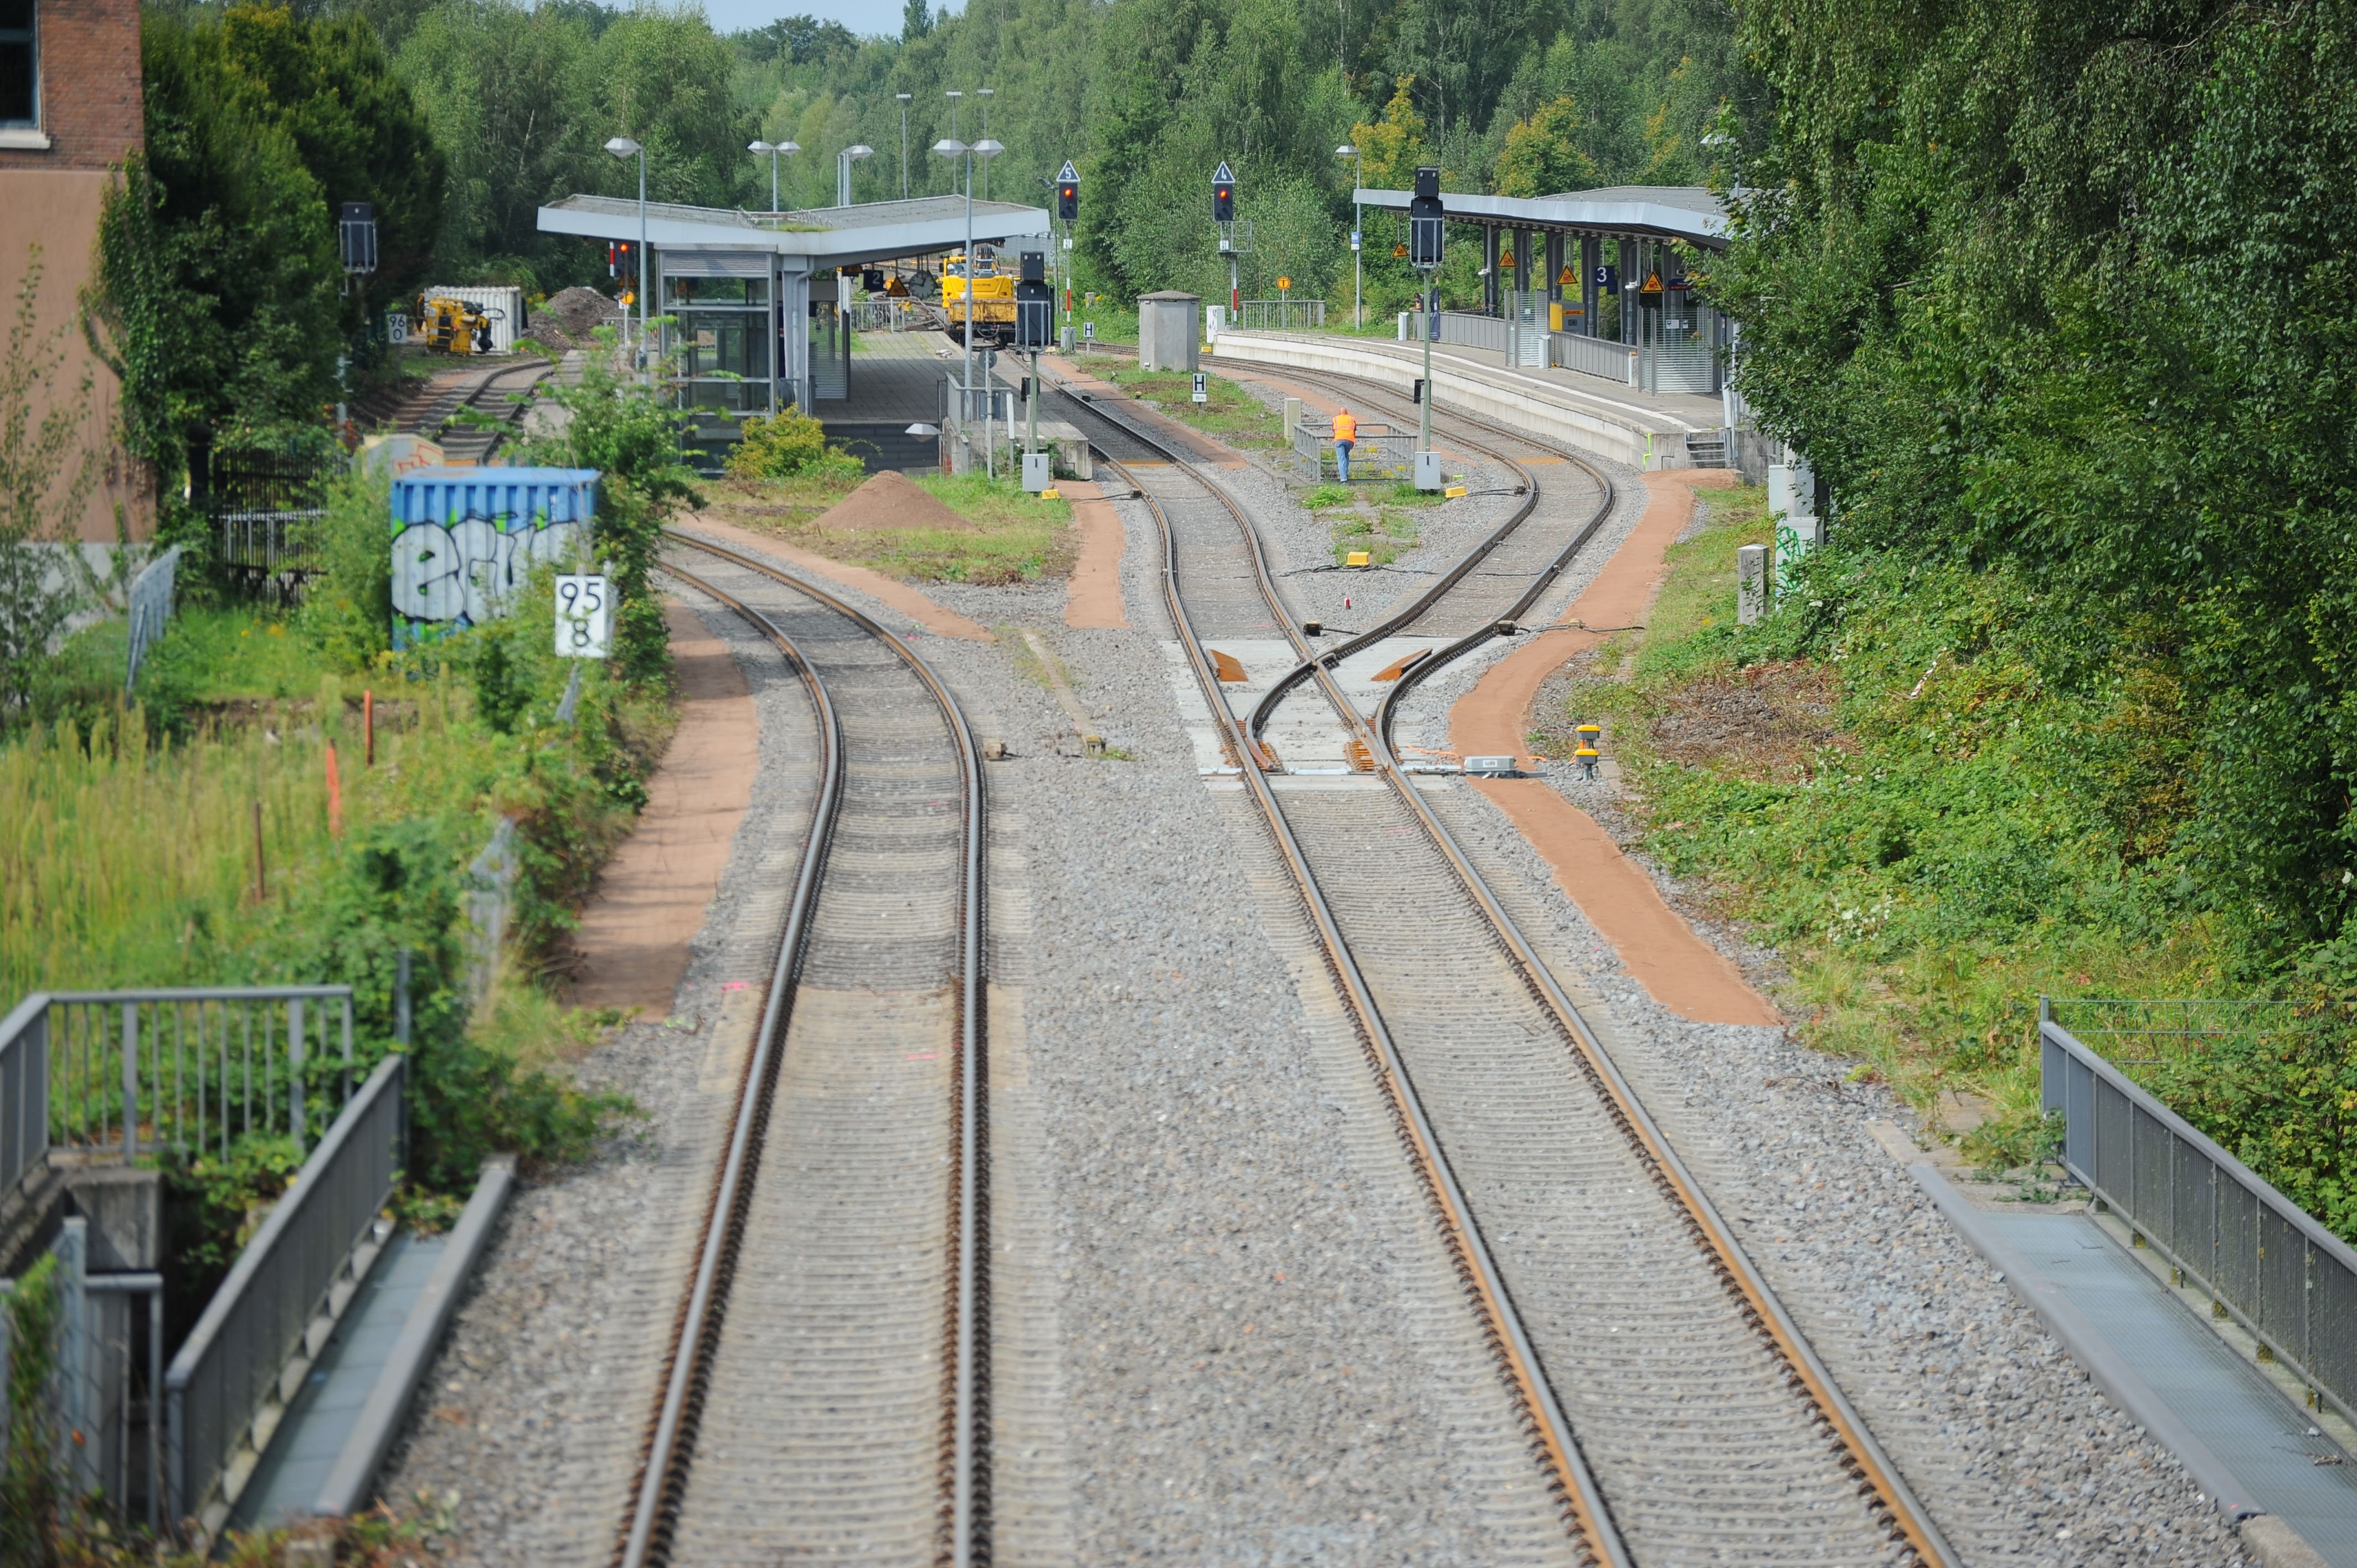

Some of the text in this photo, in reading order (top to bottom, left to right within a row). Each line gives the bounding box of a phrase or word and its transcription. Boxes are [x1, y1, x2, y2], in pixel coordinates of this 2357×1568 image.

[1065, 167, 1072, 179] 5
[1221, 168, 1227, 180] 4
[872, 272, 880, 284] 2
[1597, 267, 1607, 282] 3
[389, 316, 405, 327] 96
[393, 328, 403, 341] 0
[1085, 323, 1093, 336] H
[1194, 375, 1205, 391] H
[561, 582, 601, 613] 95
[573, 619, 590, 647] 8
